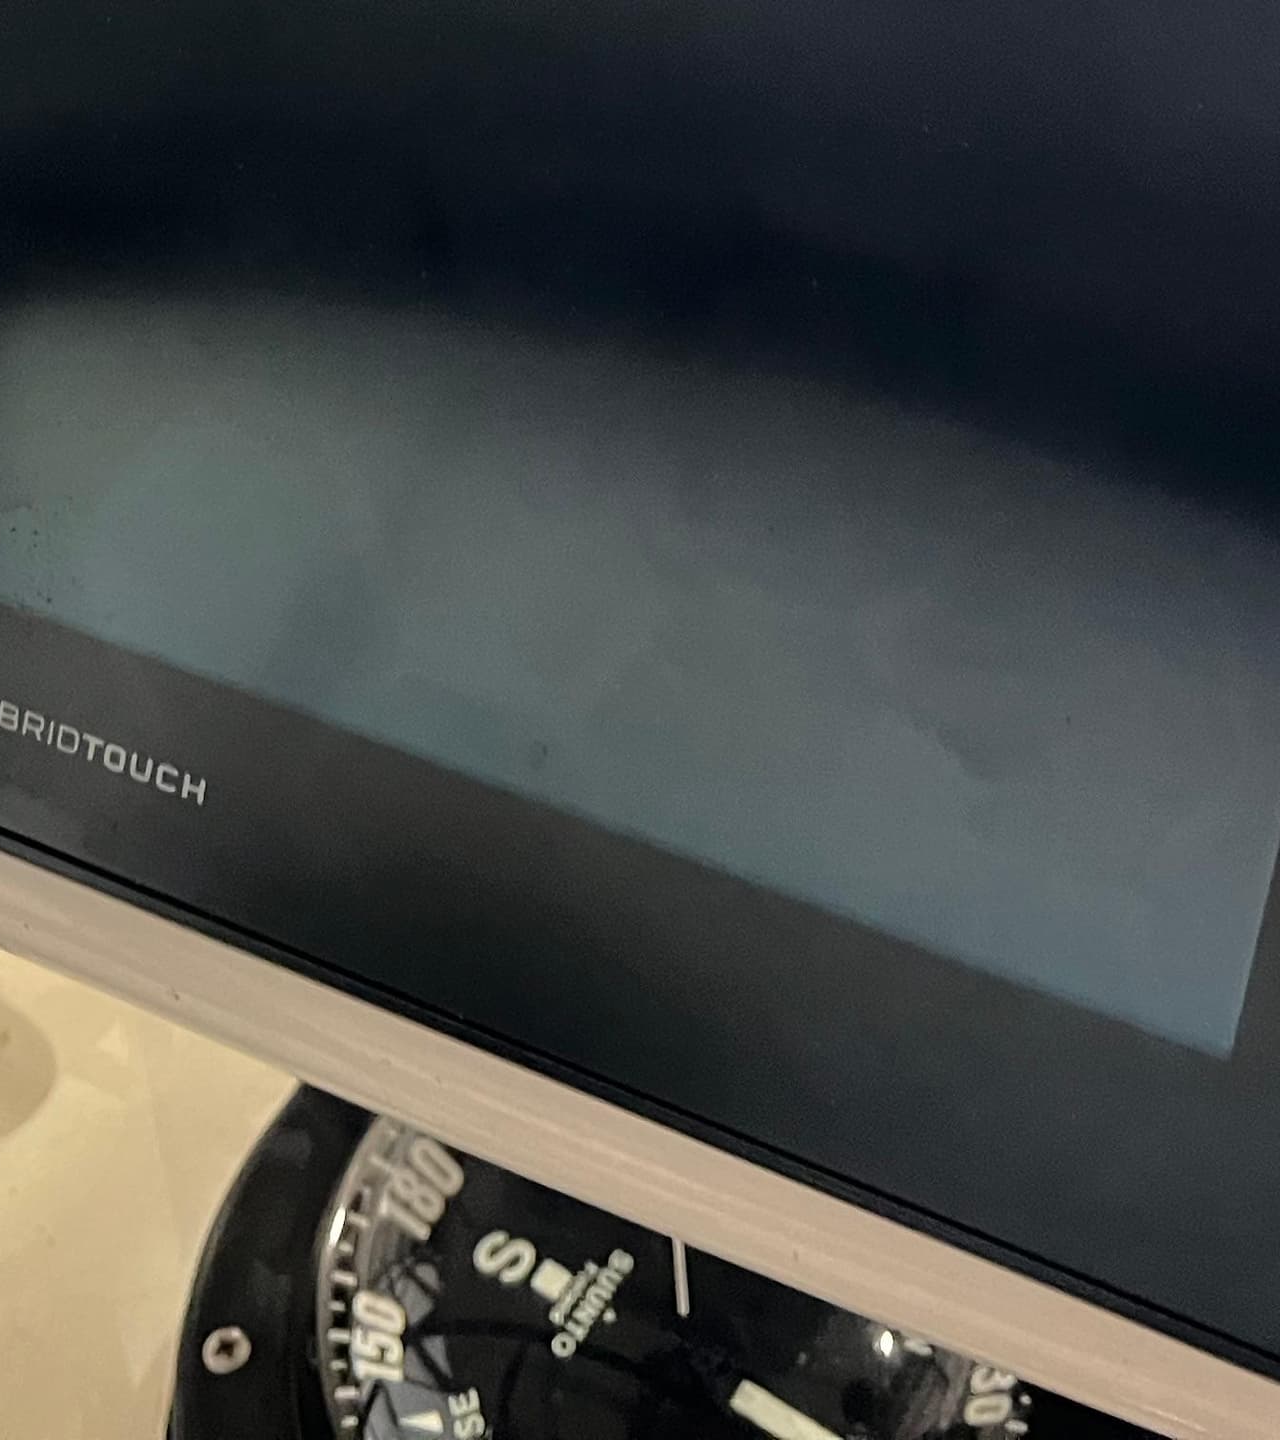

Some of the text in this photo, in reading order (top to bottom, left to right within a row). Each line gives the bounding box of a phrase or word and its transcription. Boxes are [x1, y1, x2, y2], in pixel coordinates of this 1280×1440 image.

[377, 1137, 465, 1241] 180
[473, 1229, 537, 1284] S
[351, 1289, 407, 1383] 150
[448, 1387, 486, 1440] SE
